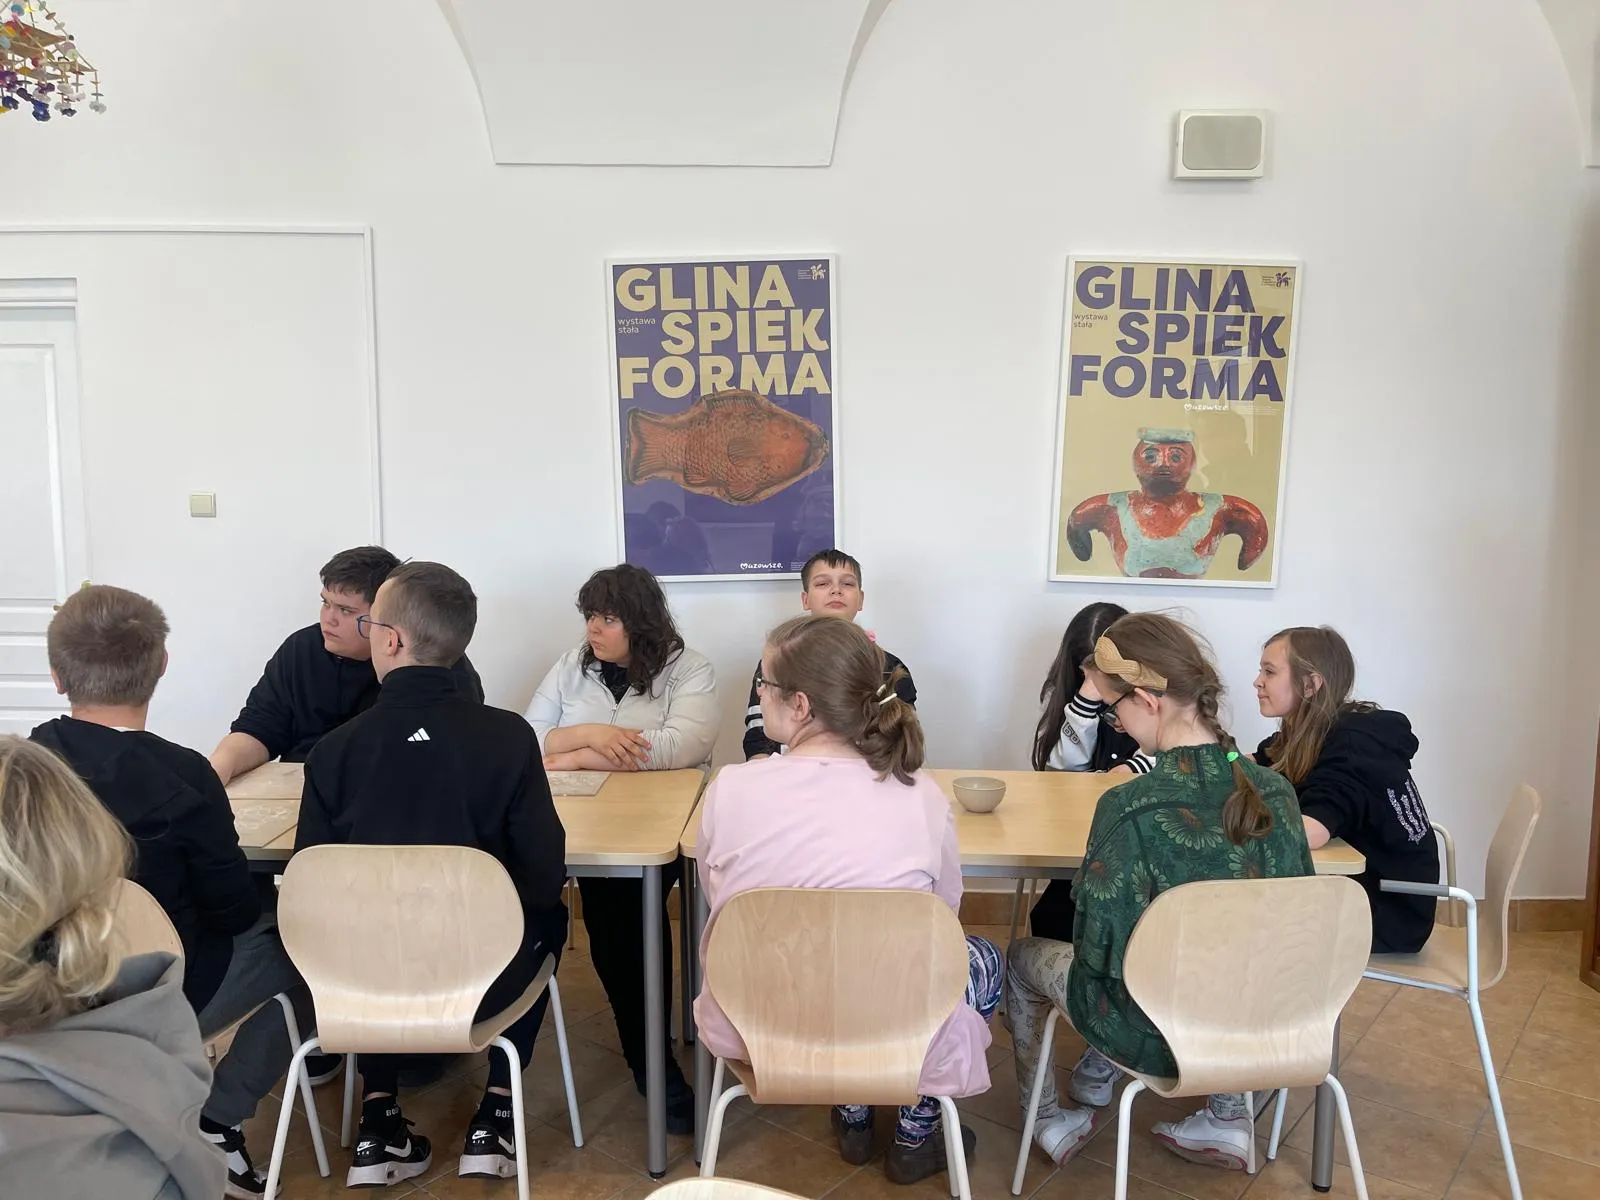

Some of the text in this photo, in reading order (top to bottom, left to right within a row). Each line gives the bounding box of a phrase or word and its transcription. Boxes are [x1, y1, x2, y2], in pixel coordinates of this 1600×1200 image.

[616, 264, 796, 312] GLINA
[1075, 265, 1256, 313] GLINA
[617, 318, 656, 327] wystawa
[618, 326, 640, 334] stała
[661, 308, 830, 355] SPIEK
[1115, 311, 1287, 359] SPIEK
[619, 352, 832, 399] FORMA
[1069, 354, 1284, 402] FORMA
